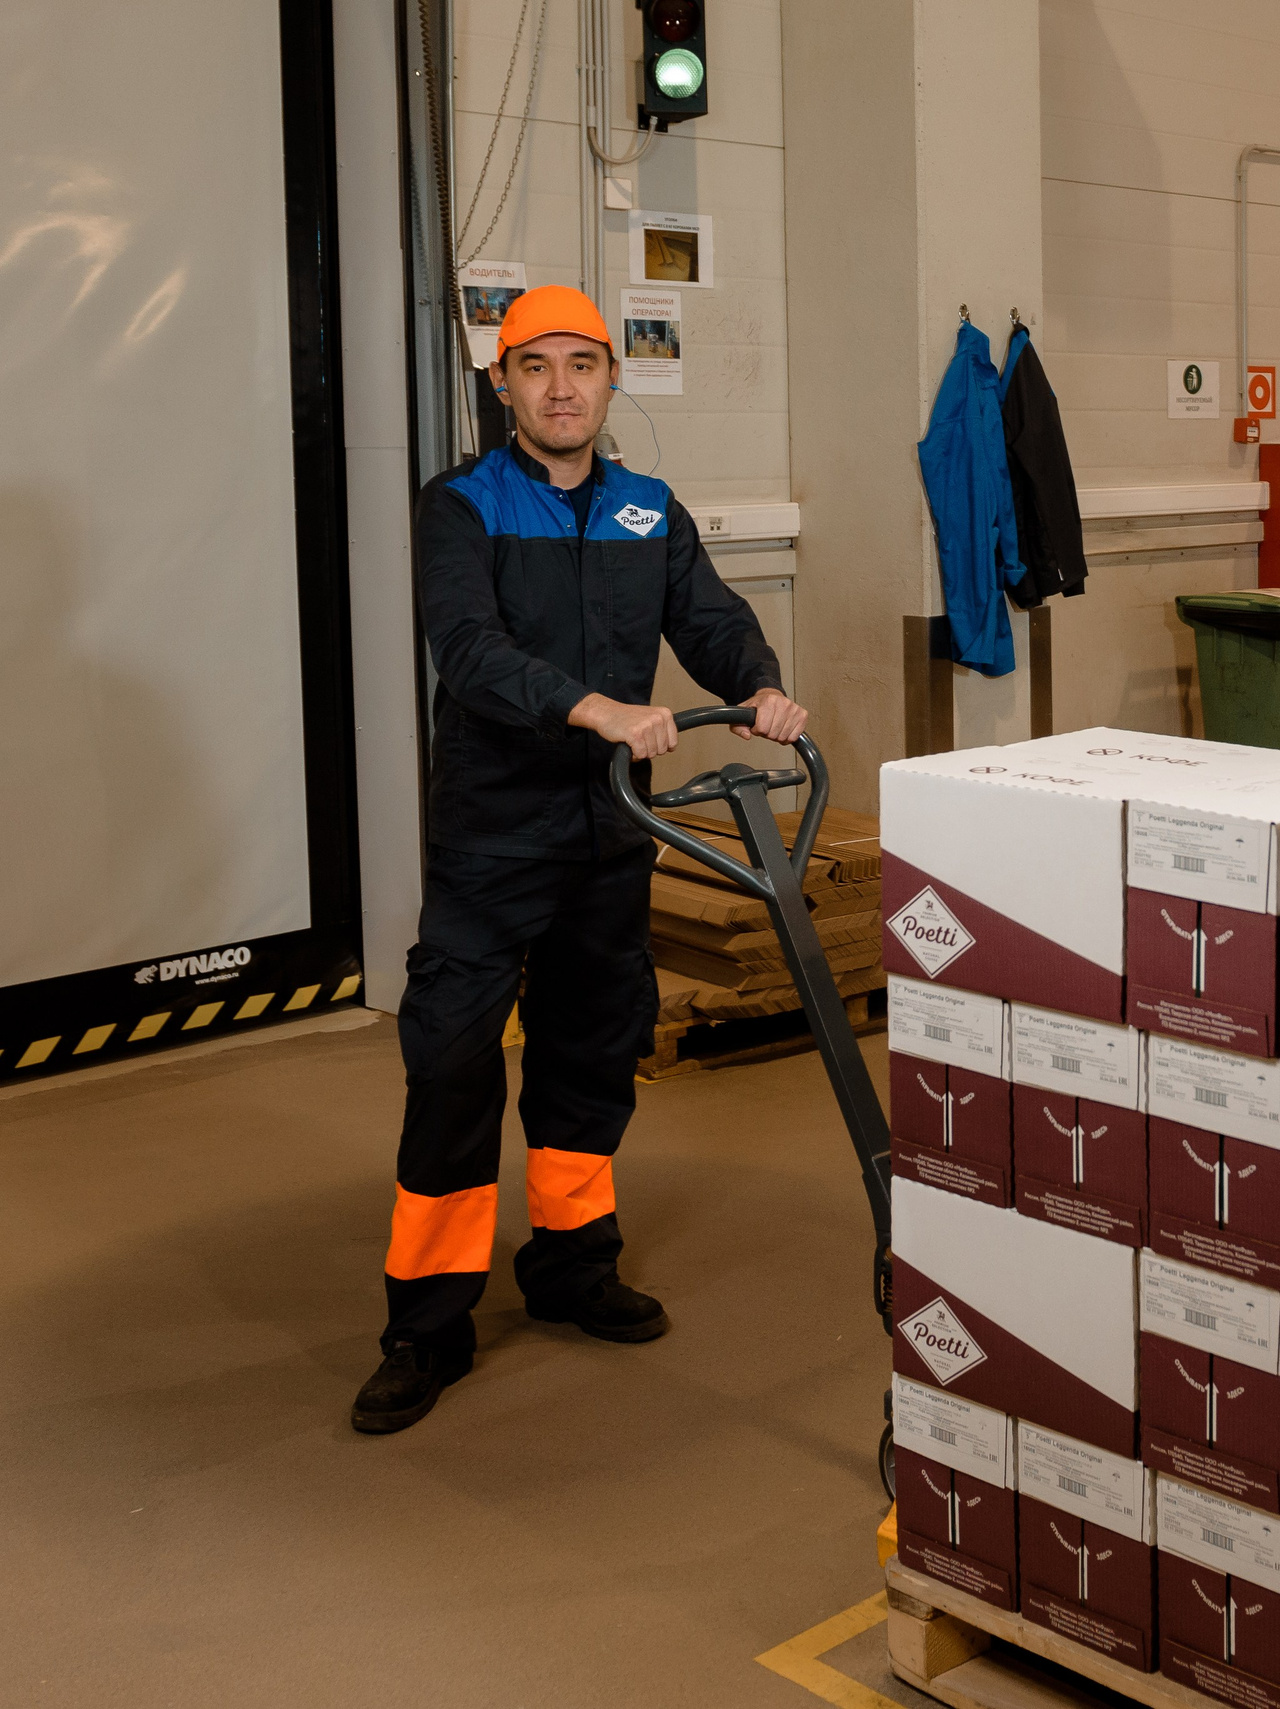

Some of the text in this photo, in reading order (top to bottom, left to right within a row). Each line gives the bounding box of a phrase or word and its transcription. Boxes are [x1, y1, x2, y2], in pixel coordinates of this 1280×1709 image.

[469, 267, 515, 278] ВОДИТЕЛЬ!
[628, 296, 674, 306] ПОМОЩНИКИ
[631, 308, 672, 317] ОПЕРАТОРА!
[620, 514, 656, 526] Poetti
[1129, 753, 1208, 767] КОФЕ
[1011, 772, 1094, 786] КОФЕ
[1149, 814, 1224, 831] Poetti Leggenda Original
[902, 916, 958, 946] Poetti
[159, 946, 251, 982] DYNACO
[195, 972, 239, 984] www.dynaco.ru
[903, 986, 966, 1006] Poetti Leggenda Original
[1028, 1015, 1097, 1035] Poetti Leggenda Original
[1170, 1044, 1246, 1068] Poetti Leggenda Original
[1160, 1264, 1235, 1293] Poetti Leggenda Original
[913, 1322, 970, 1358] Poetti
[910, 1386, 970, 1413] Poetti Leggenda Original
[1036, 1432, 1102, 1464] Poetti Leggenda Original
[1178, 1484, 1252, 1517] Poetti Leggenda Original
